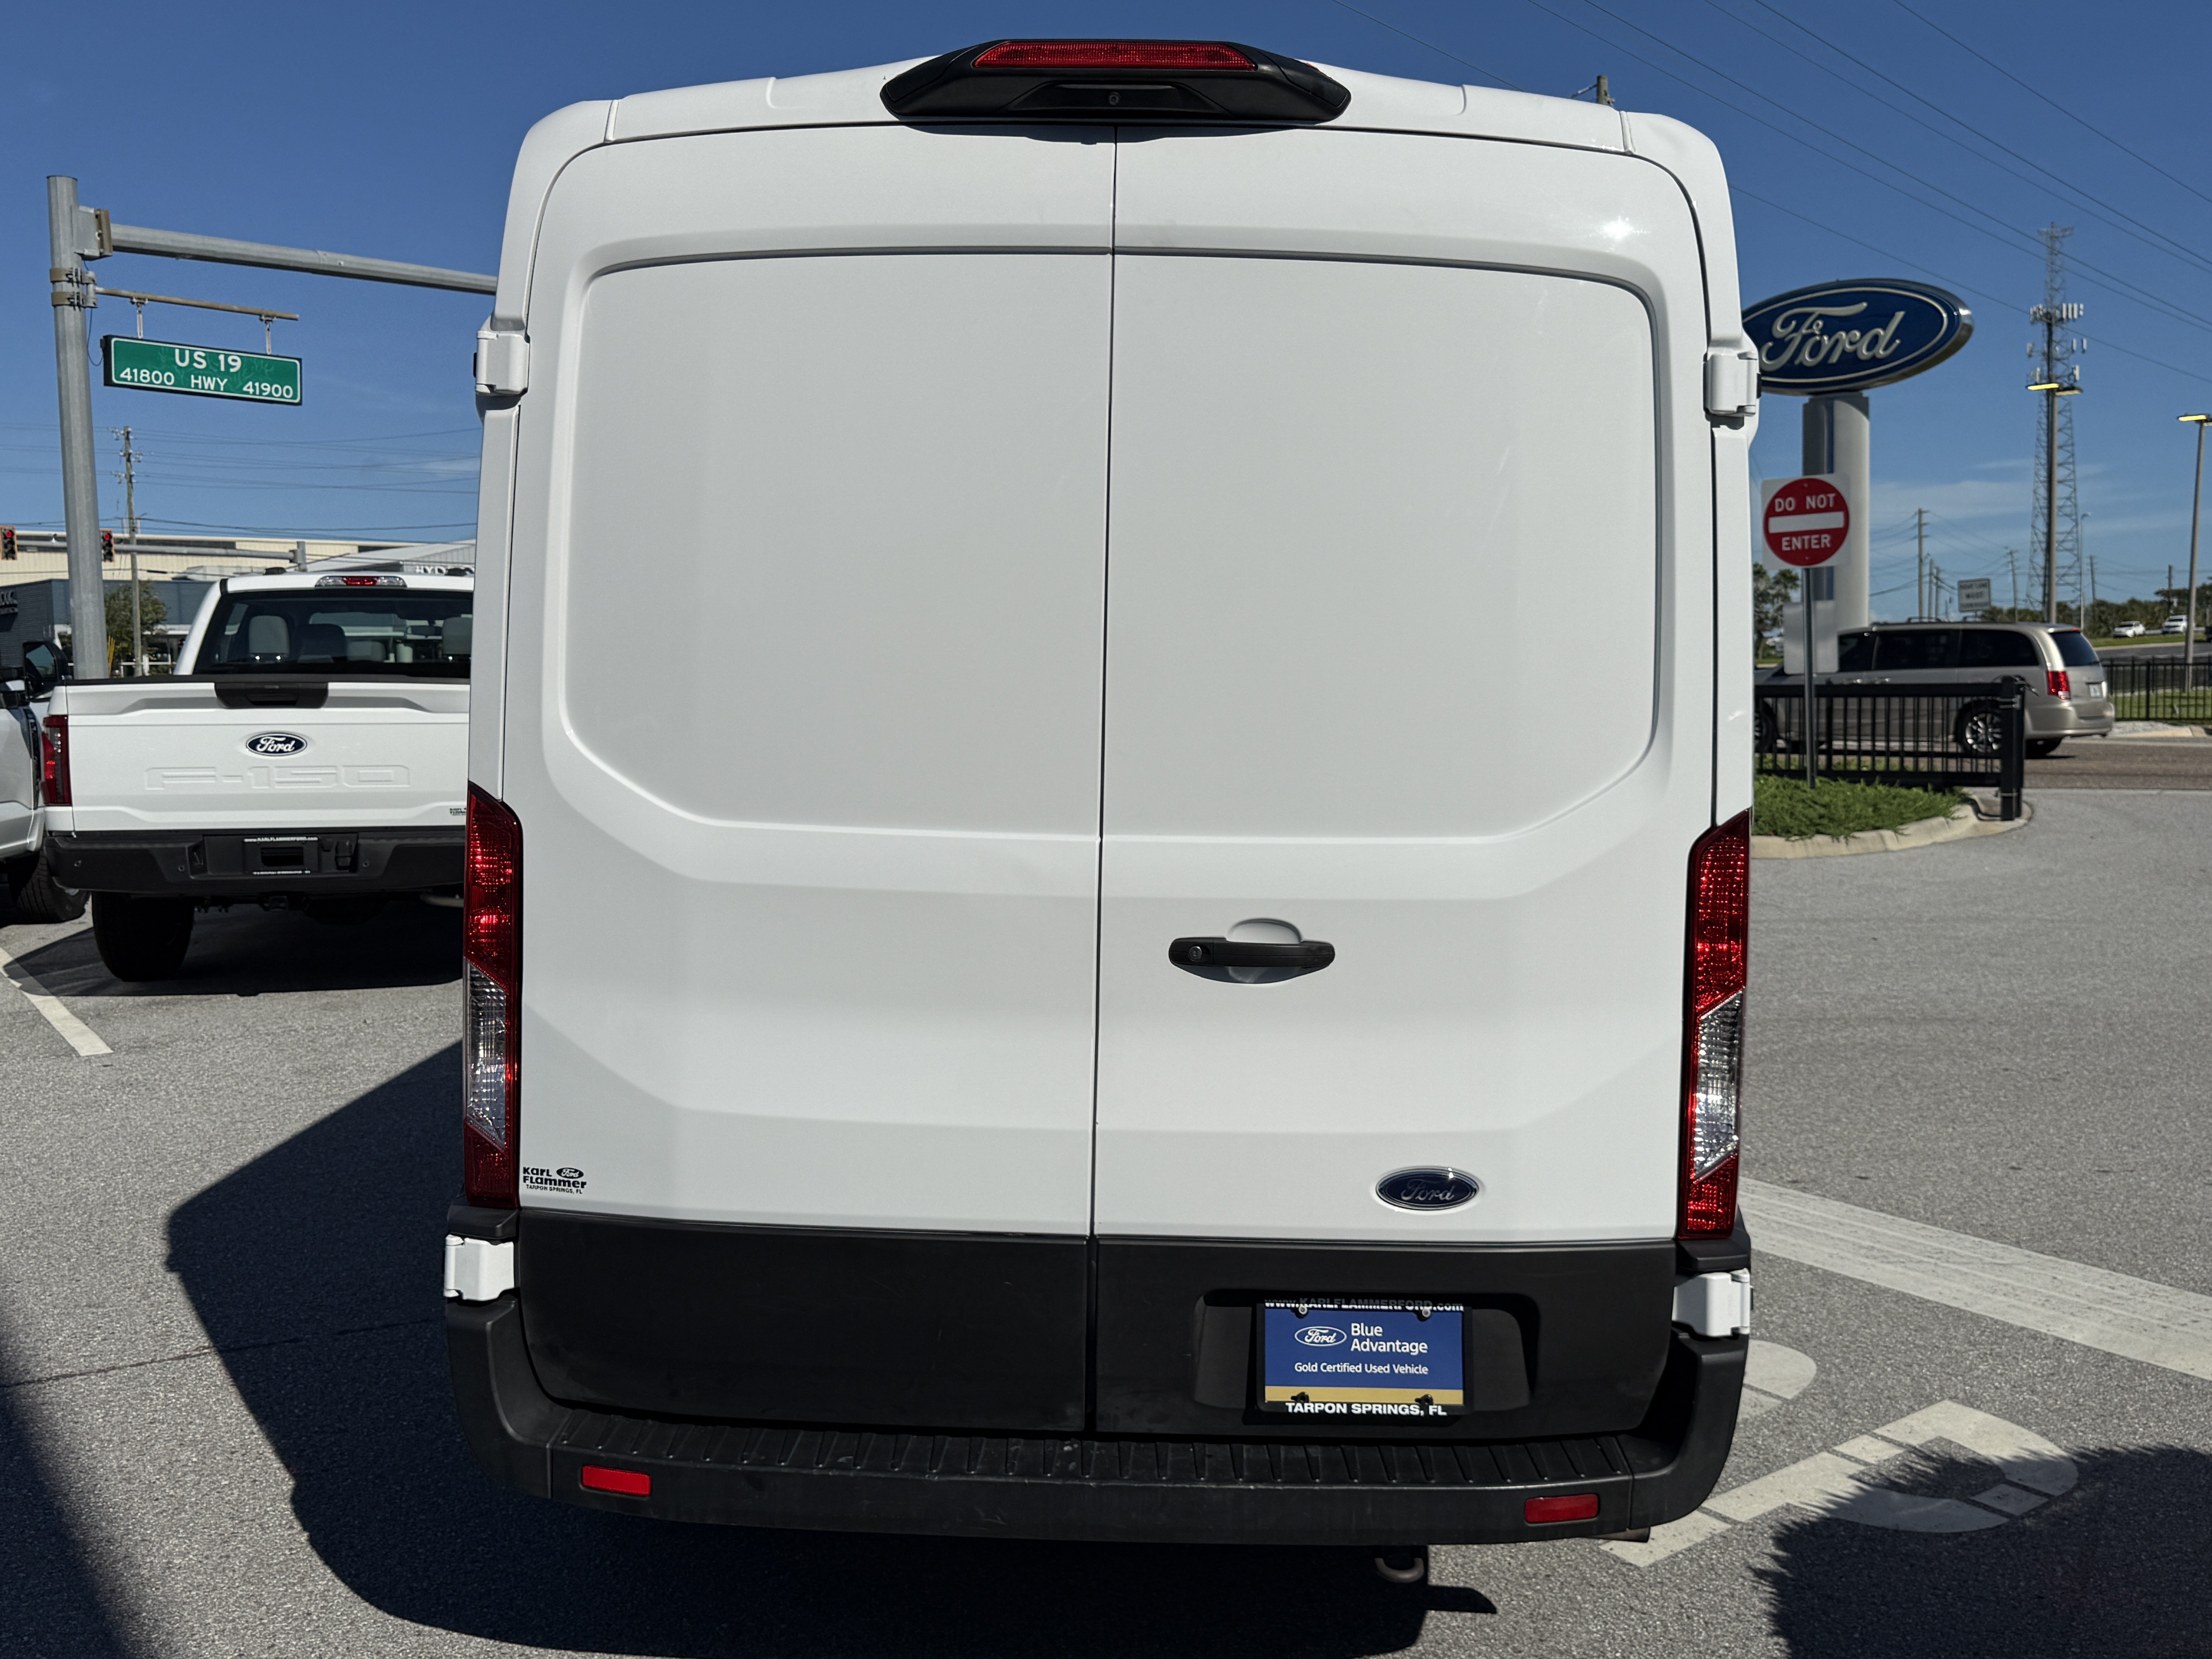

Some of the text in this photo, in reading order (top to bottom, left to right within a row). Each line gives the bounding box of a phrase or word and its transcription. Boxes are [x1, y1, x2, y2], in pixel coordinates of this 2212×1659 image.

[1760, 302, 1906, 371] Ford
[175, 349, 241, 372] US 19
[120, 368, 293, 398] 41800 HWY 41900
[1775, 493, 1836, 512] DO NOT
[1782, 534, 1831, 551] ENTER
[256, 736, 295, 752] Ford
[145, 765, 410, 790] F-150
[562, 1168, 579, 1177] Ford
[1400, 1179, 1455, 1200] Ford
[1305, 1329, 1336, 1343] Ford
[1351, 1323, 1382, 1337] Blue
[1351, 1338, 1428, 1355] Advantage
[1295, 1363, 1429, 1375] Gold Certified Used Vehicle
[1286, 1403, 1447, 1417] TARPON SPRINGS, FL
